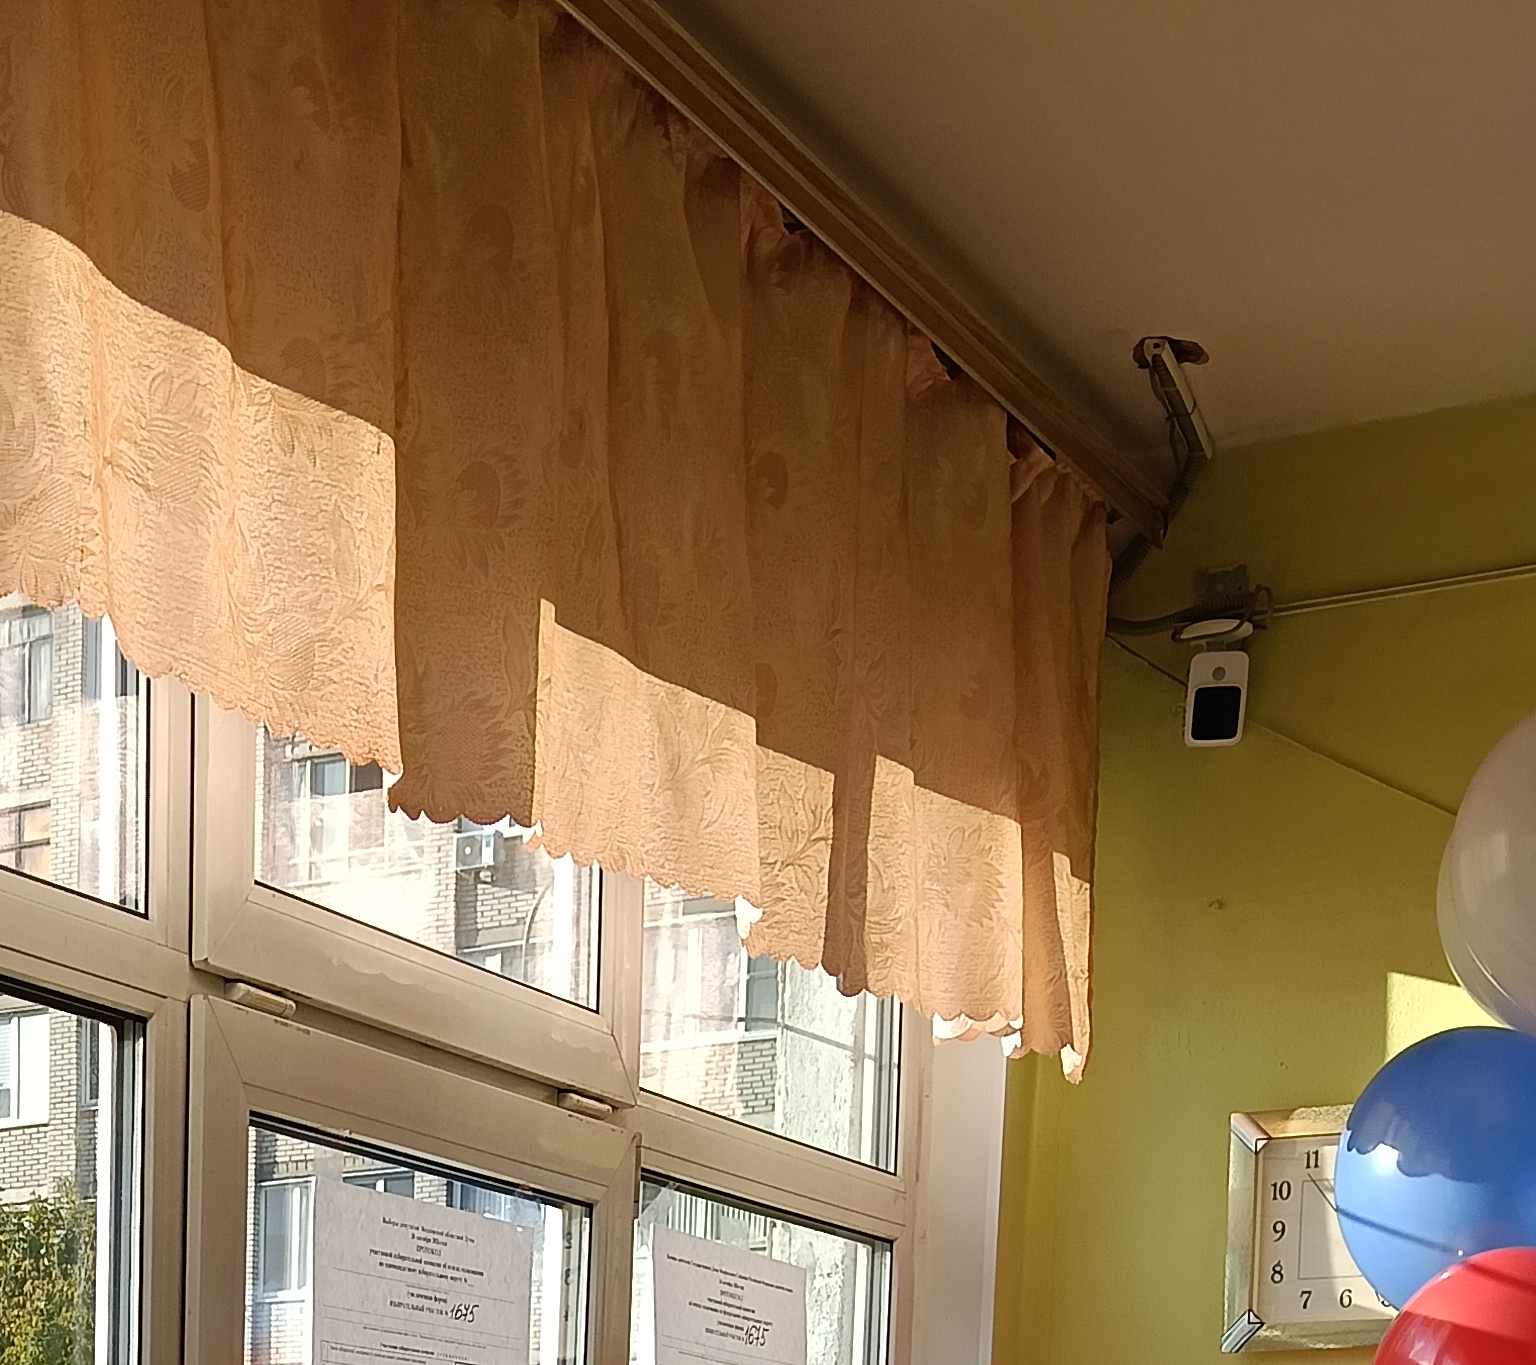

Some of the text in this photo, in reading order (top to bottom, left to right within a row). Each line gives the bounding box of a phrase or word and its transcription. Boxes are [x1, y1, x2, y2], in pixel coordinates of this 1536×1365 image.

[1304, 1150, 1320, 1169] 11
[1270, 1181, 1292, 1201] 10
[1272, 1220, 1286, 1242] 9
[1270, 1261, 1284, 1284] 8
[1299, 1290, 1312, 1310] 7
[1339, 1289, 1353, 1309] 6
